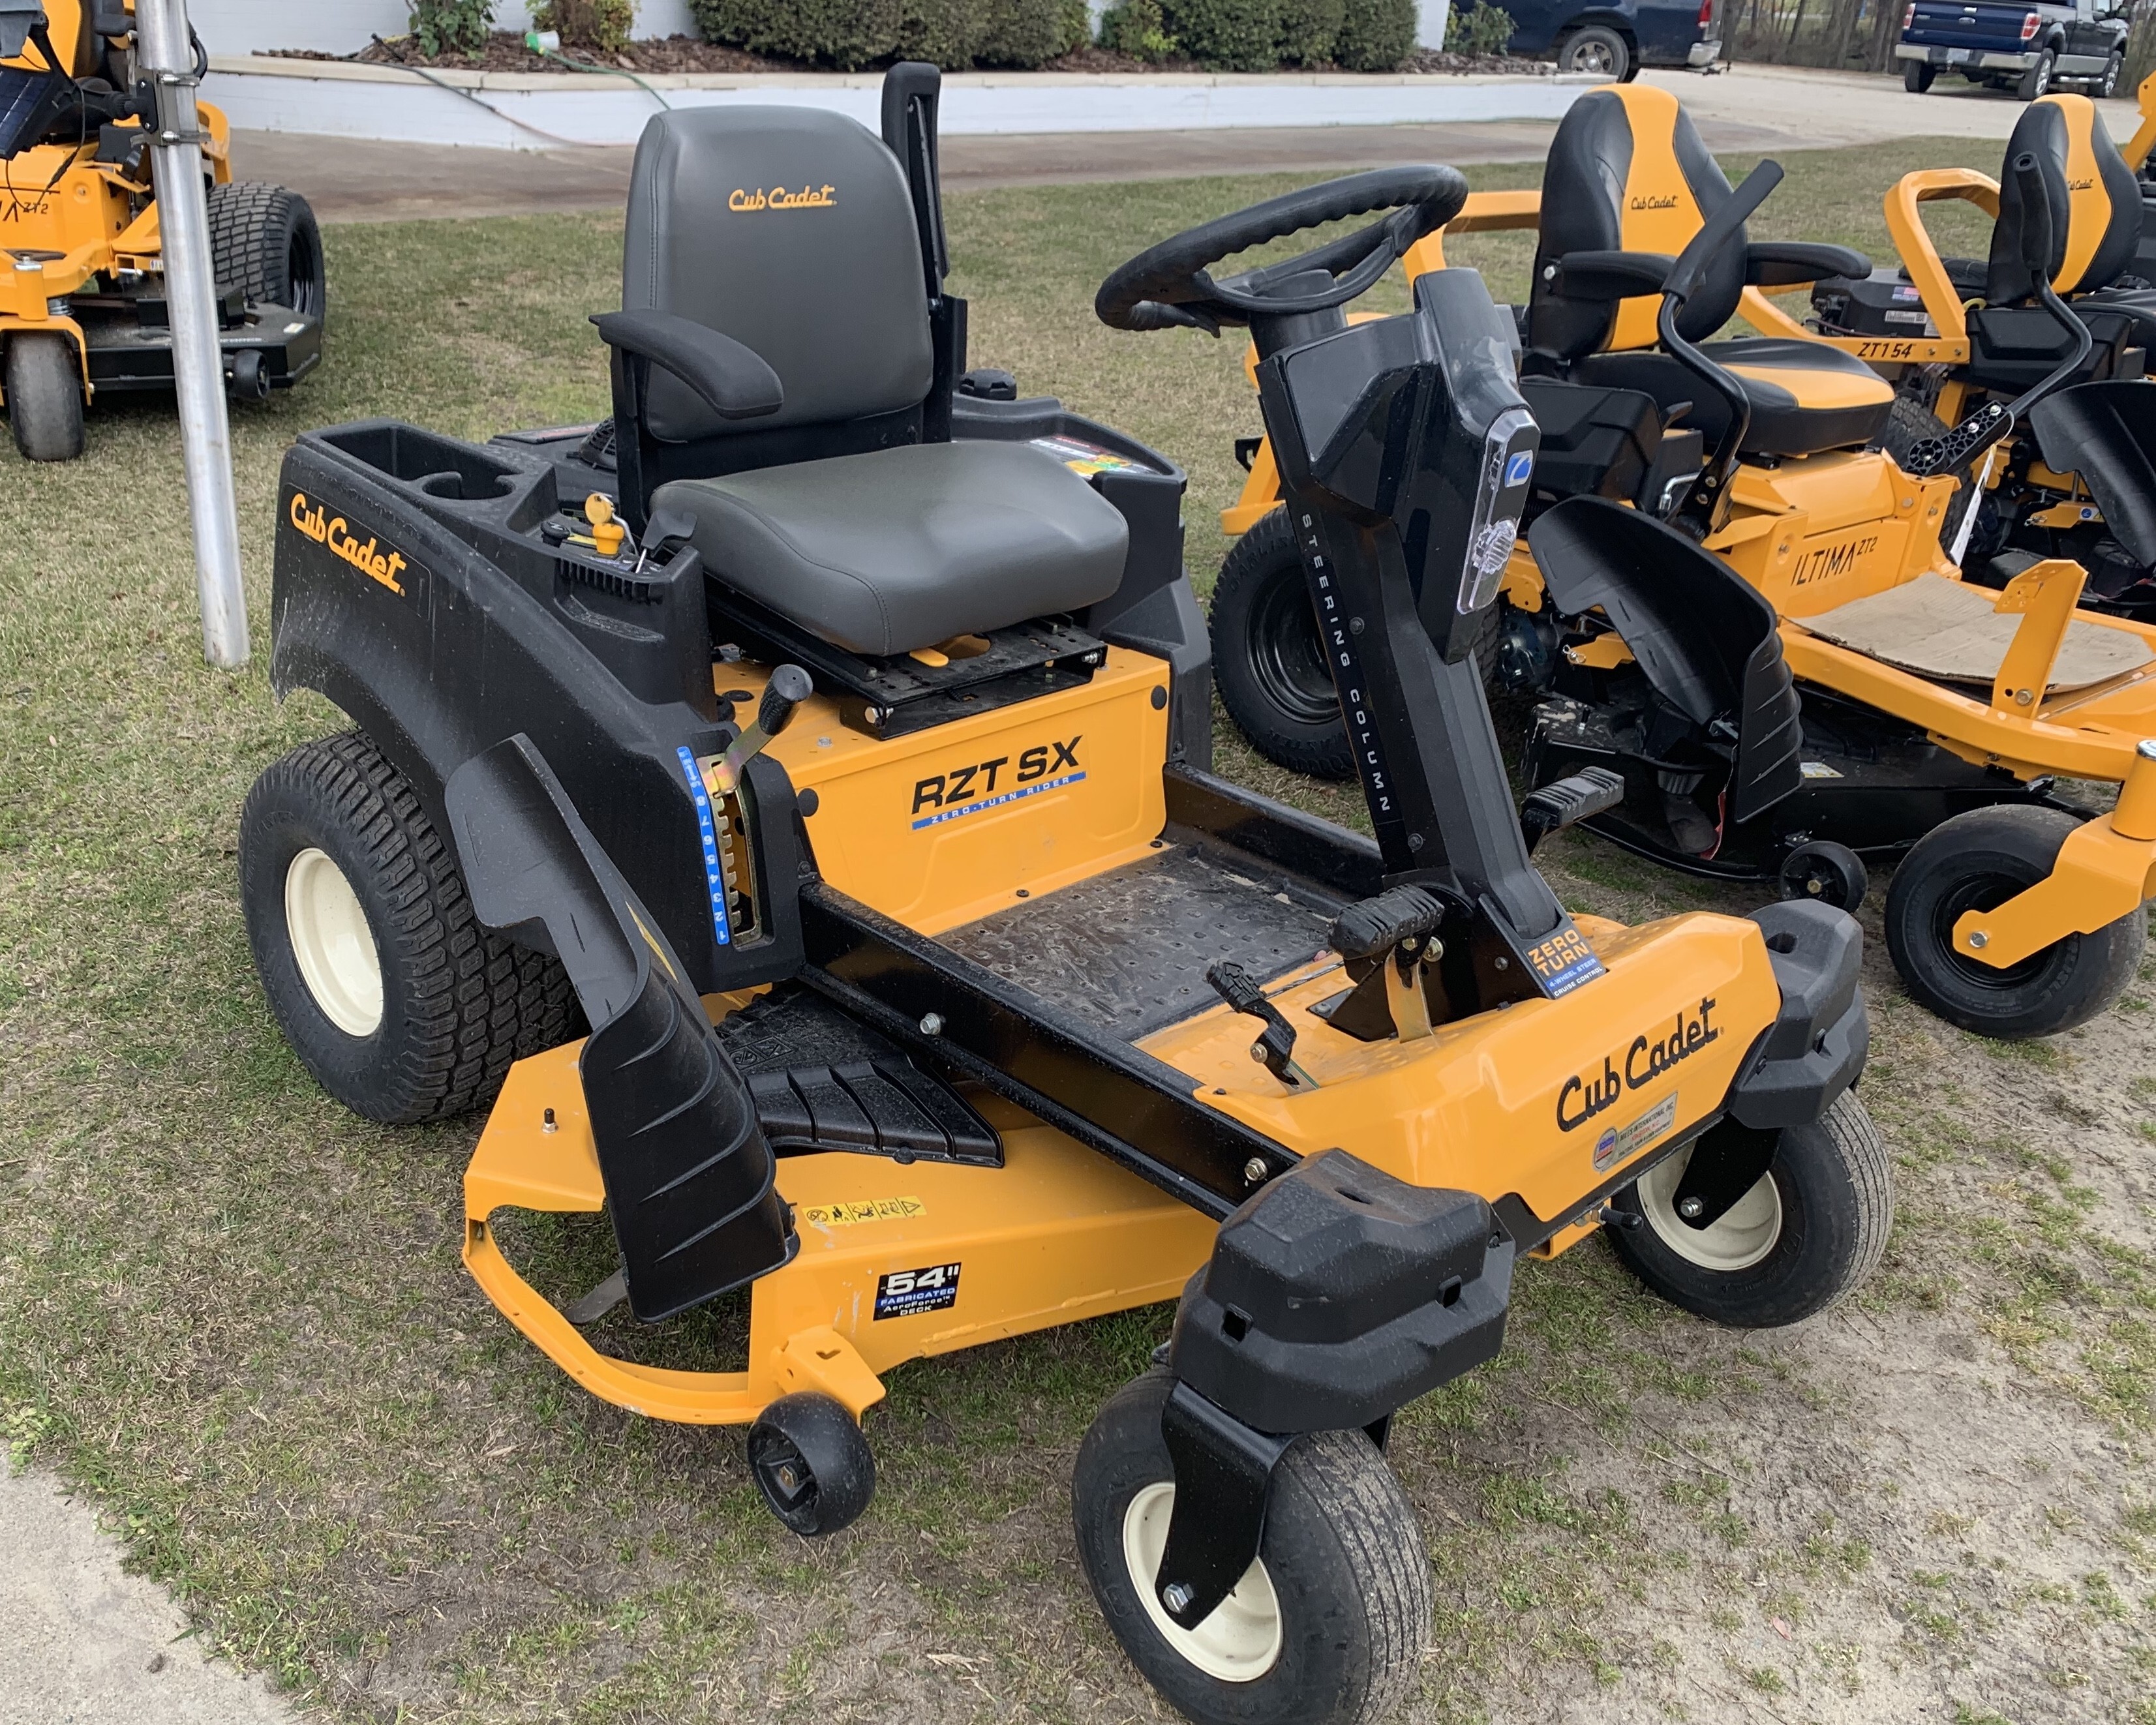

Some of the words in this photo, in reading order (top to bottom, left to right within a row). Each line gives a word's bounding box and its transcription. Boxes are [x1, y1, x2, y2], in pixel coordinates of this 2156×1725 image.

[729, 188, 767, 212] Cub
[768, 184, 836, 209] Cadet
[1631, 196, 1647, 209] Cub
[1648, 195, 1677, 209] Cadet
[1857, 342, 1890, 357] ZT1
[1890, 343, 1913, 358] 54
[291, 493, 326, 543] Cub
[327, 517, 406, 595] Cadet
[1302, 513, 1350, 667] STEERING
[1350, 688, 1391, 811] COLUMN
[911, 756, 1009, 815] RZT
[1017, 735, 1084, 782] SX
[1027, 776, 1070, 795] RIDER
[697, 795, 706, 807] 8
[701, 815, 710, 826] 7
[703, 835, 713, 846] 6
[706, 854, 716, 865] 5
[710, 873, 719, 884] 4
[712, 892, 721, 903] 3
[715, 911, 724, 922] 2
[720, 931, 726, 940] 1
[1528, 929, 1579, 965] ZERO
[1536, 942, 1590, 976] TURN
[1549, 970, 1577, 987] 4-WHEEL
[1576, 958, 1597, 972] STEER
[1553, 981, 1577, 997] CRUISE
[1576, 967, 1603, 983] CONTROL
[1556, 1055, 1621, 1132] Cub
[1625, 997, 1718, 1090] Cadet
[886, 1265, 960, 1296] 54"
[881, 1287, 956, 1306] FABRICATED
[900, 1305, 932, 1316] DECK
